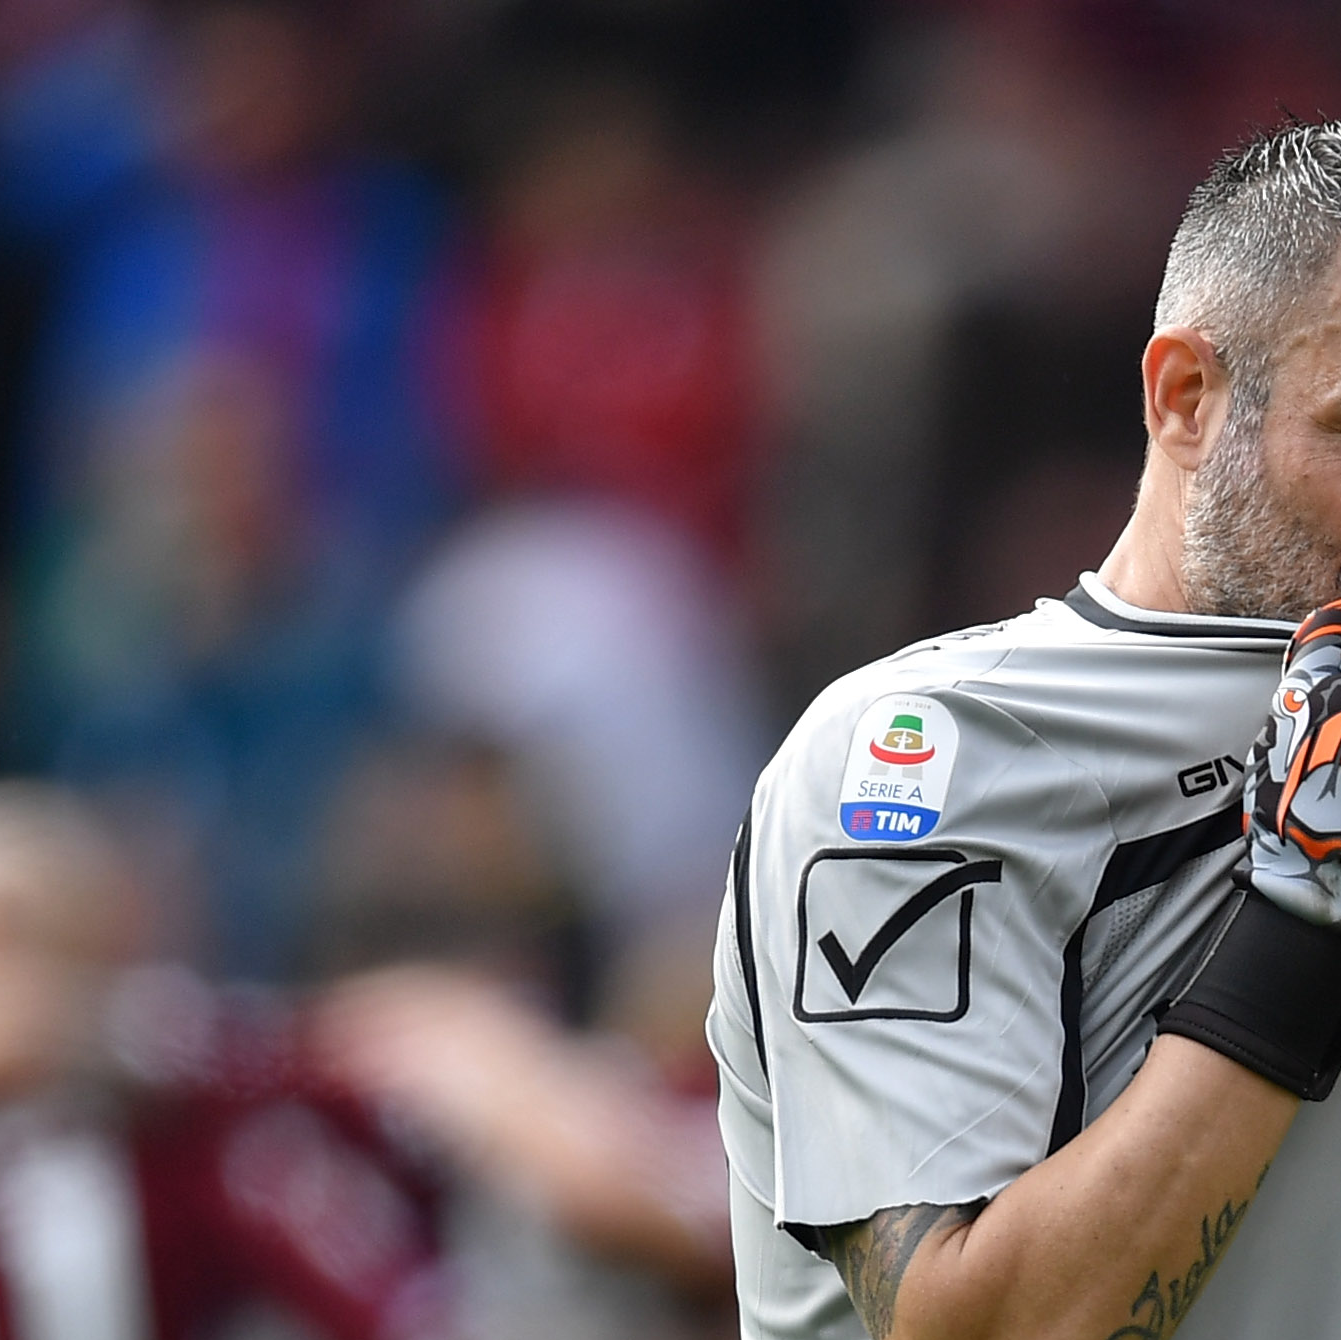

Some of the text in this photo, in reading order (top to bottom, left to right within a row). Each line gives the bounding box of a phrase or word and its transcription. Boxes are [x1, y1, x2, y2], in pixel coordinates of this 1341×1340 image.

[858, 780, 923, 803] SERIE A
[876, 810, 921, 835] TIM
